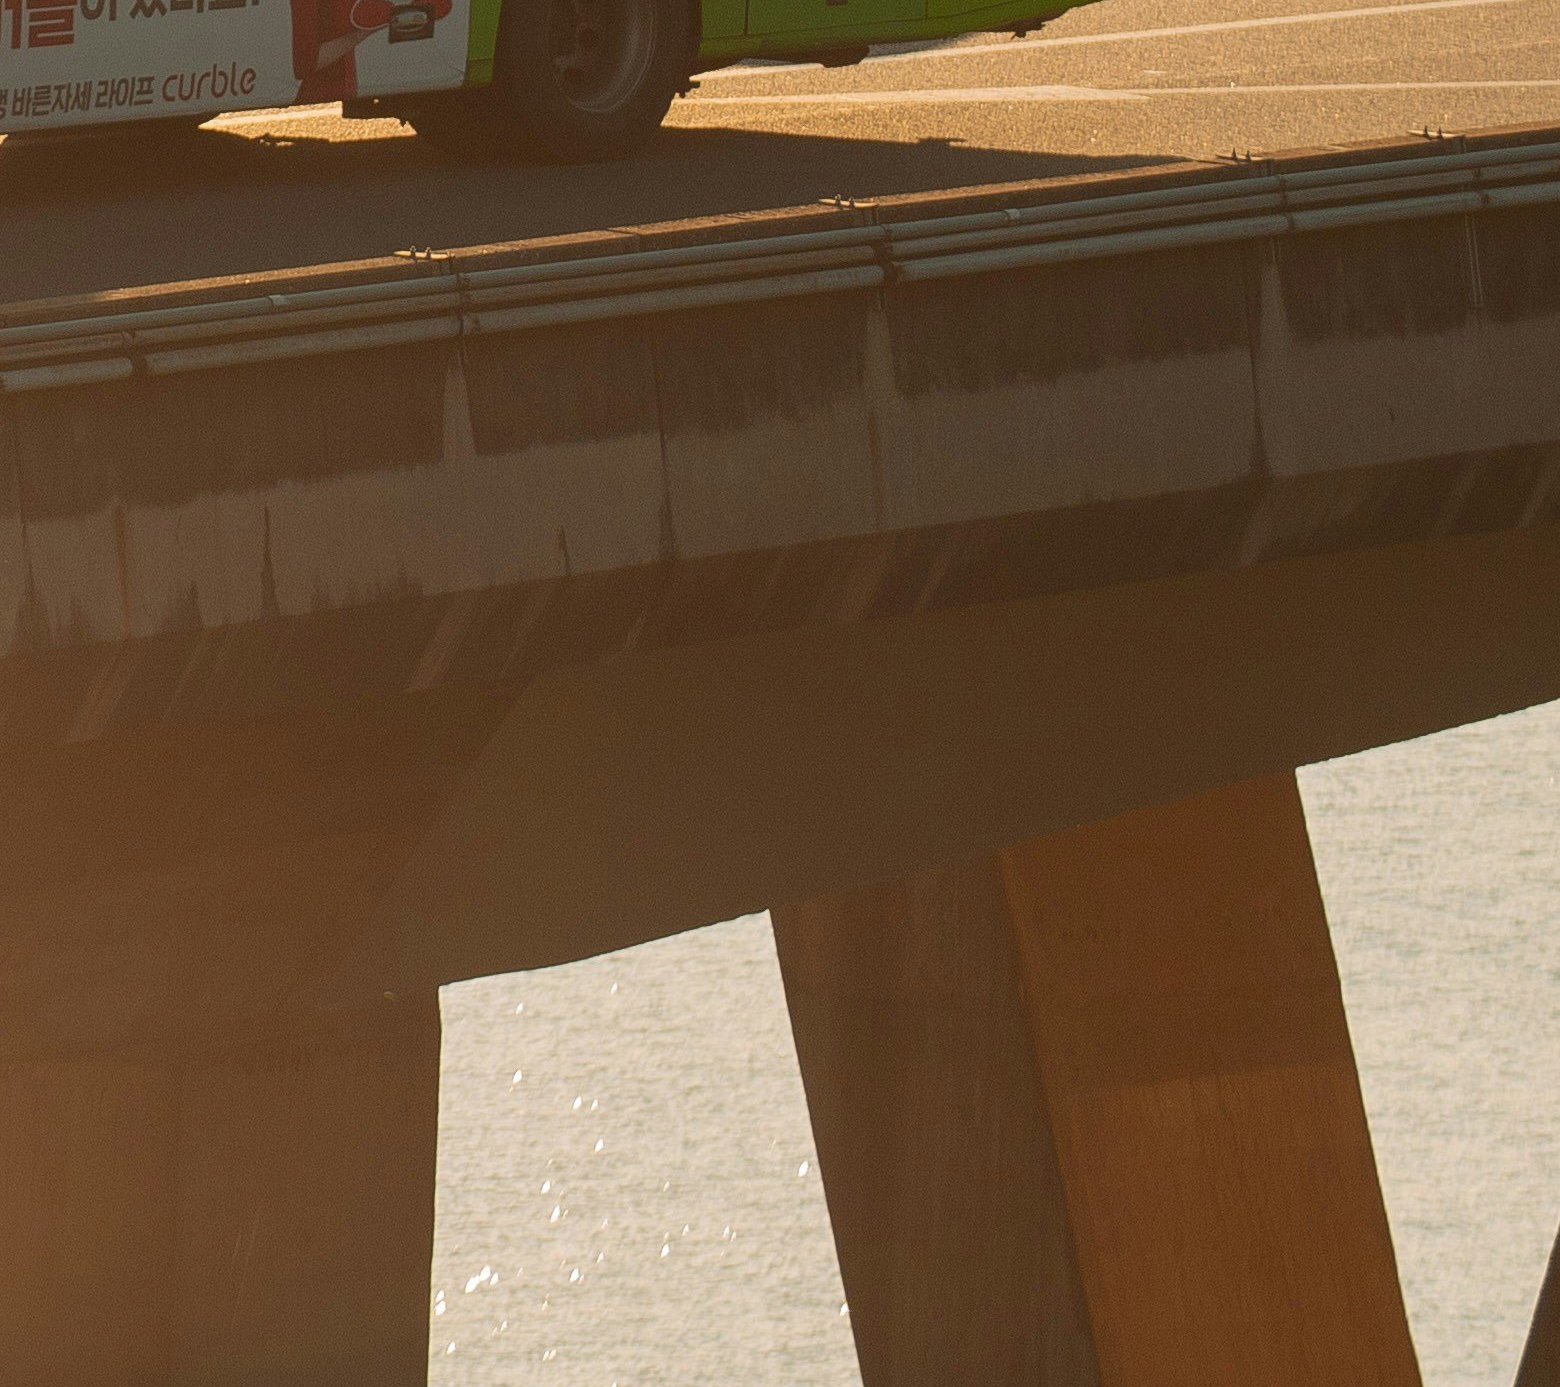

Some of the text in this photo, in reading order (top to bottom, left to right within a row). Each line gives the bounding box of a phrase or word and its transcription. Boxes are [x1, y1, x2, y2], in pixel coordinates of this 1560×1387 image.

[11, 80, 93, 118] 바른자세
[94, 75, 156, 109] 라이프
[161, 61, 257, 103] curble
